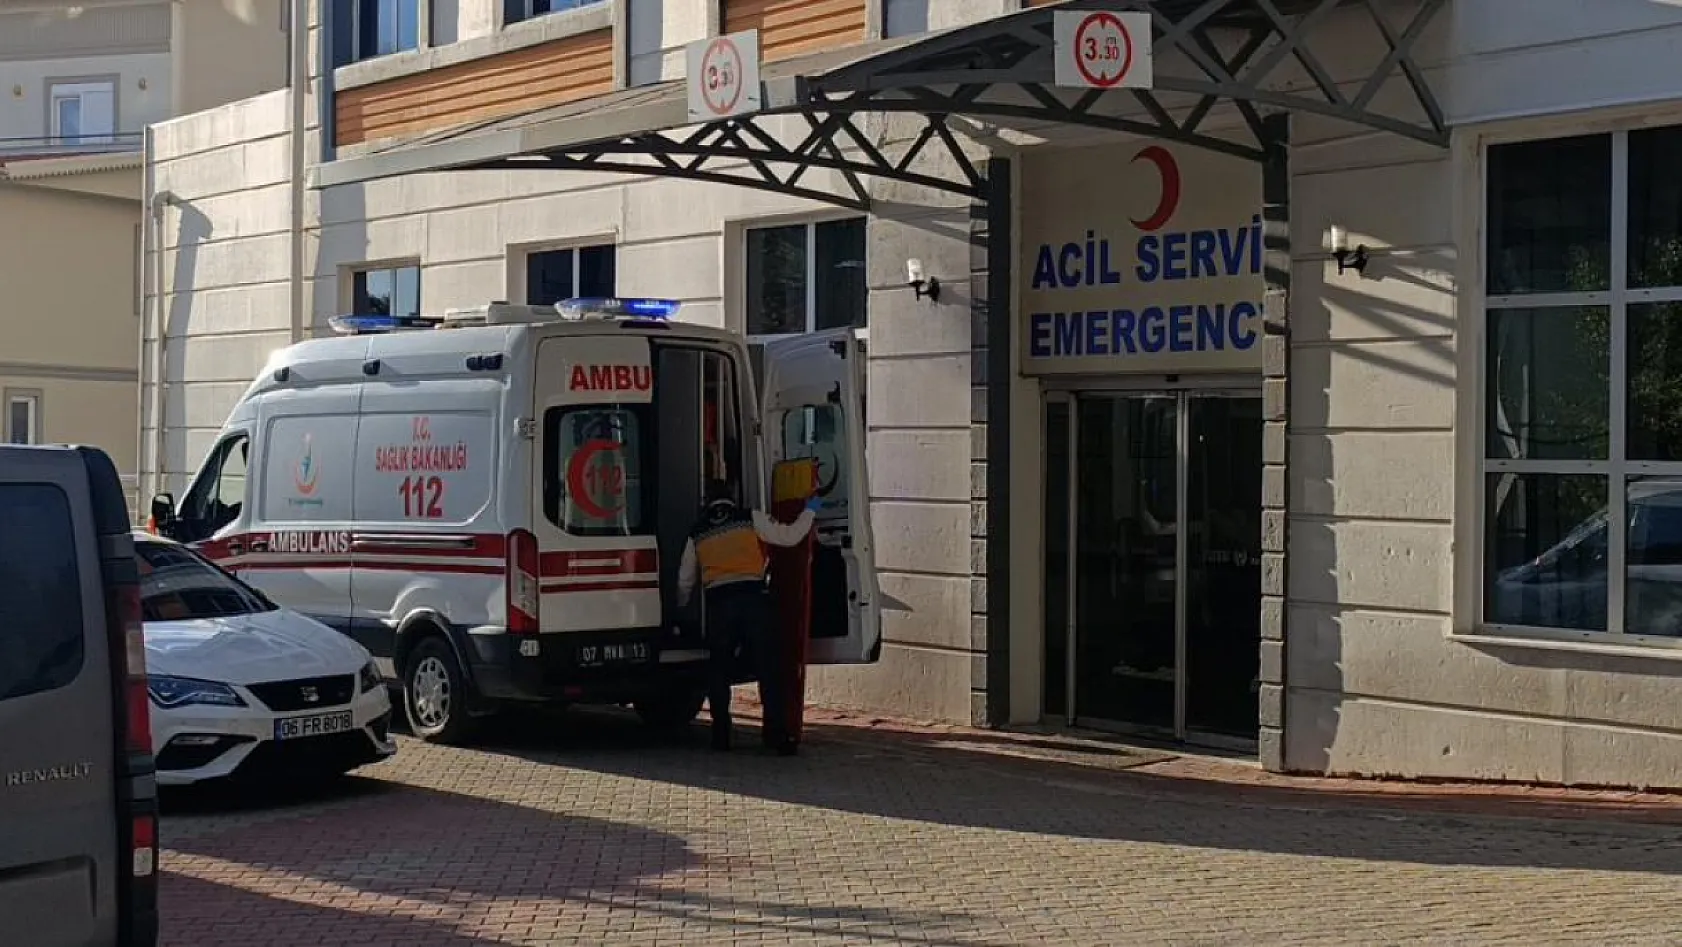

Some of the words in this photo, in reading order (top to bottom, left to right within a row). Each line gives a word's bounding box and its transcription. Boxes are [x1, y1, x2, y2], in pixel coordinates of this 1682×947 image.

[1032, 230, 1121, 289] ACİL
[1136, 214, 1262, 283] SERVİ
[1031, 301, 1263, 357] EMERGENC
[570, 364, 653, 391] AMBU
[586, 464, 622, 495] 112
[399, 475, 444, 517] 112
[268, 531, 349, 552] AMBULANS
[303, 717, 321, 735] FR
[6, 761, 94, 786] RENAULT
